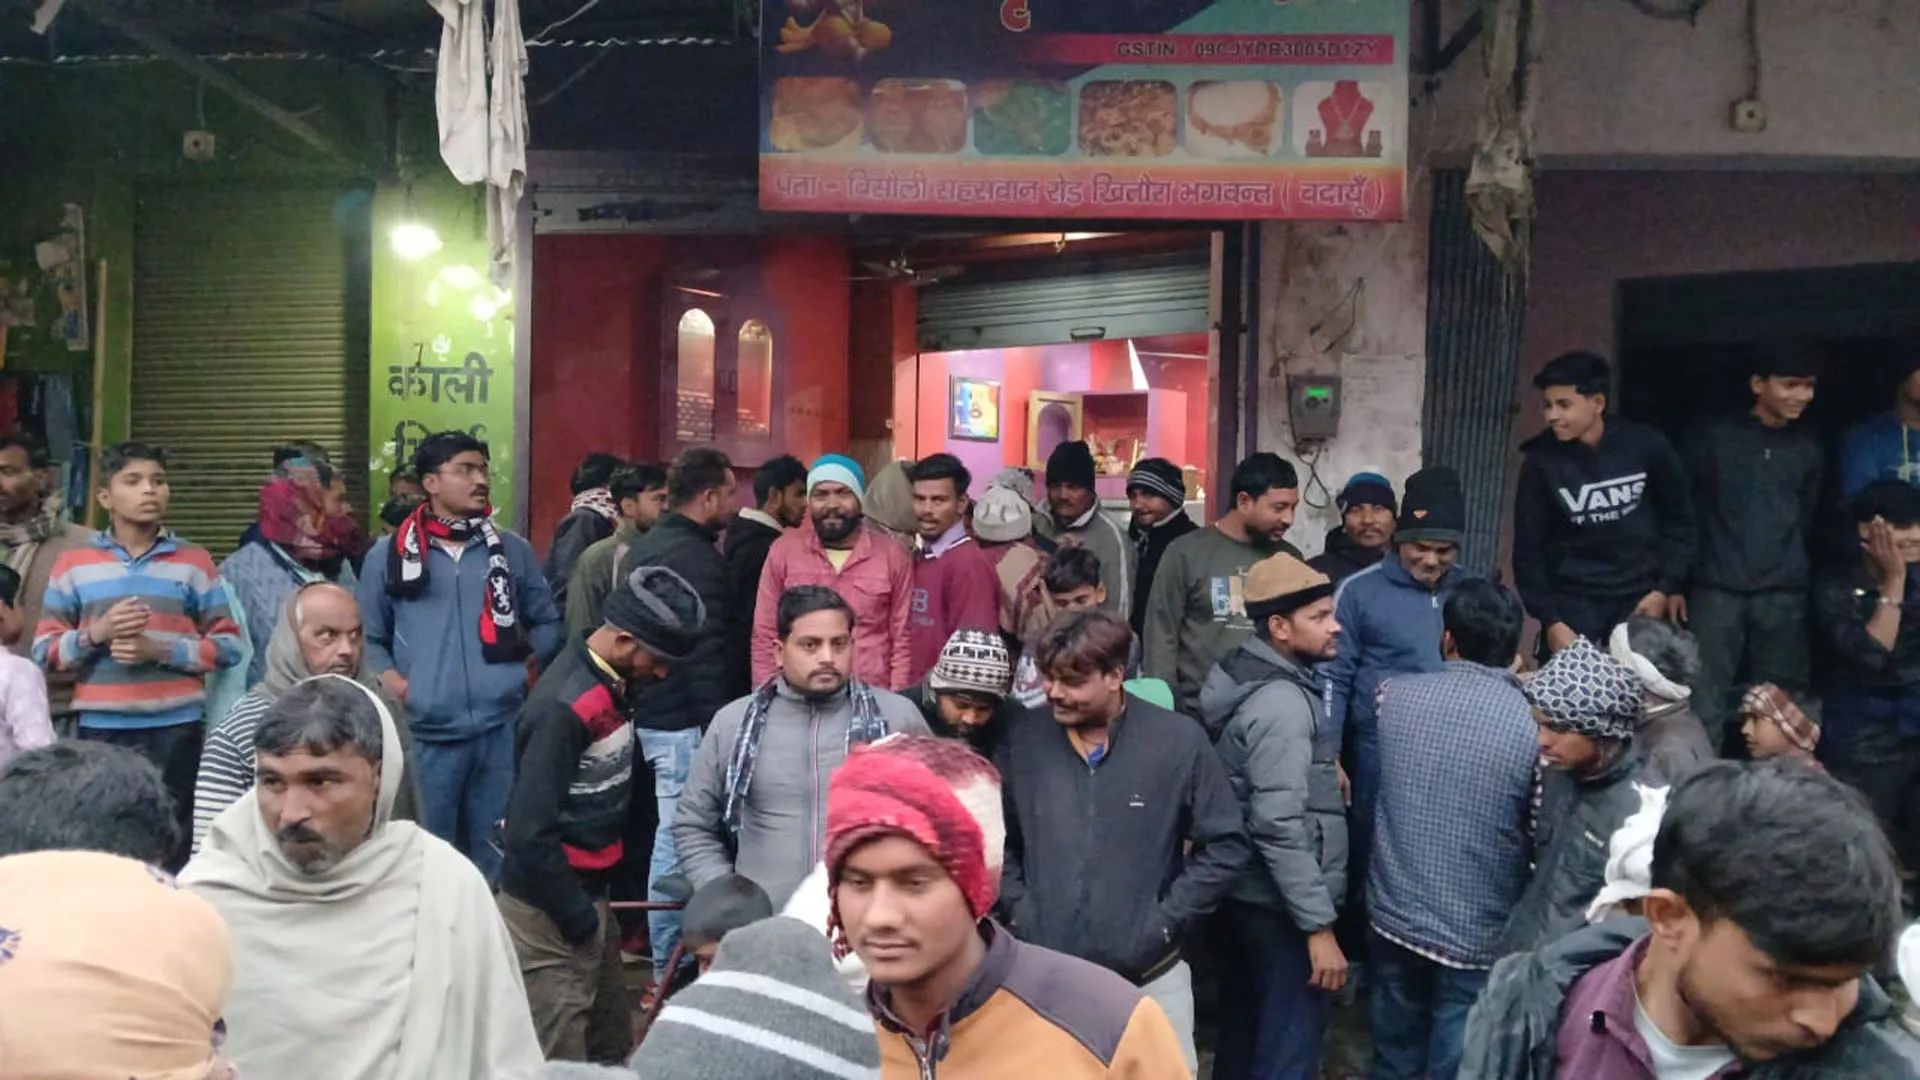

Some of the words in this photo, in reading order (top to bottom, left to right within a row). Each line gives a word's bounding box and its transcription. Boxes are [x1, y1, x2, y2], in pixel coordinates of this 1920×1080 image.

[1117, 41, 1176, 56] GSTIN
[775, 174, 818, 197] पता
[935, 179, 1039, 203] सहसवान
[1045, 173, 1084, 205] रोड
[1179, 180, 1273, 205] भगवन्त
[388, 352, 494, 404] काली
[1558, 472, 1647, 512] VANS
